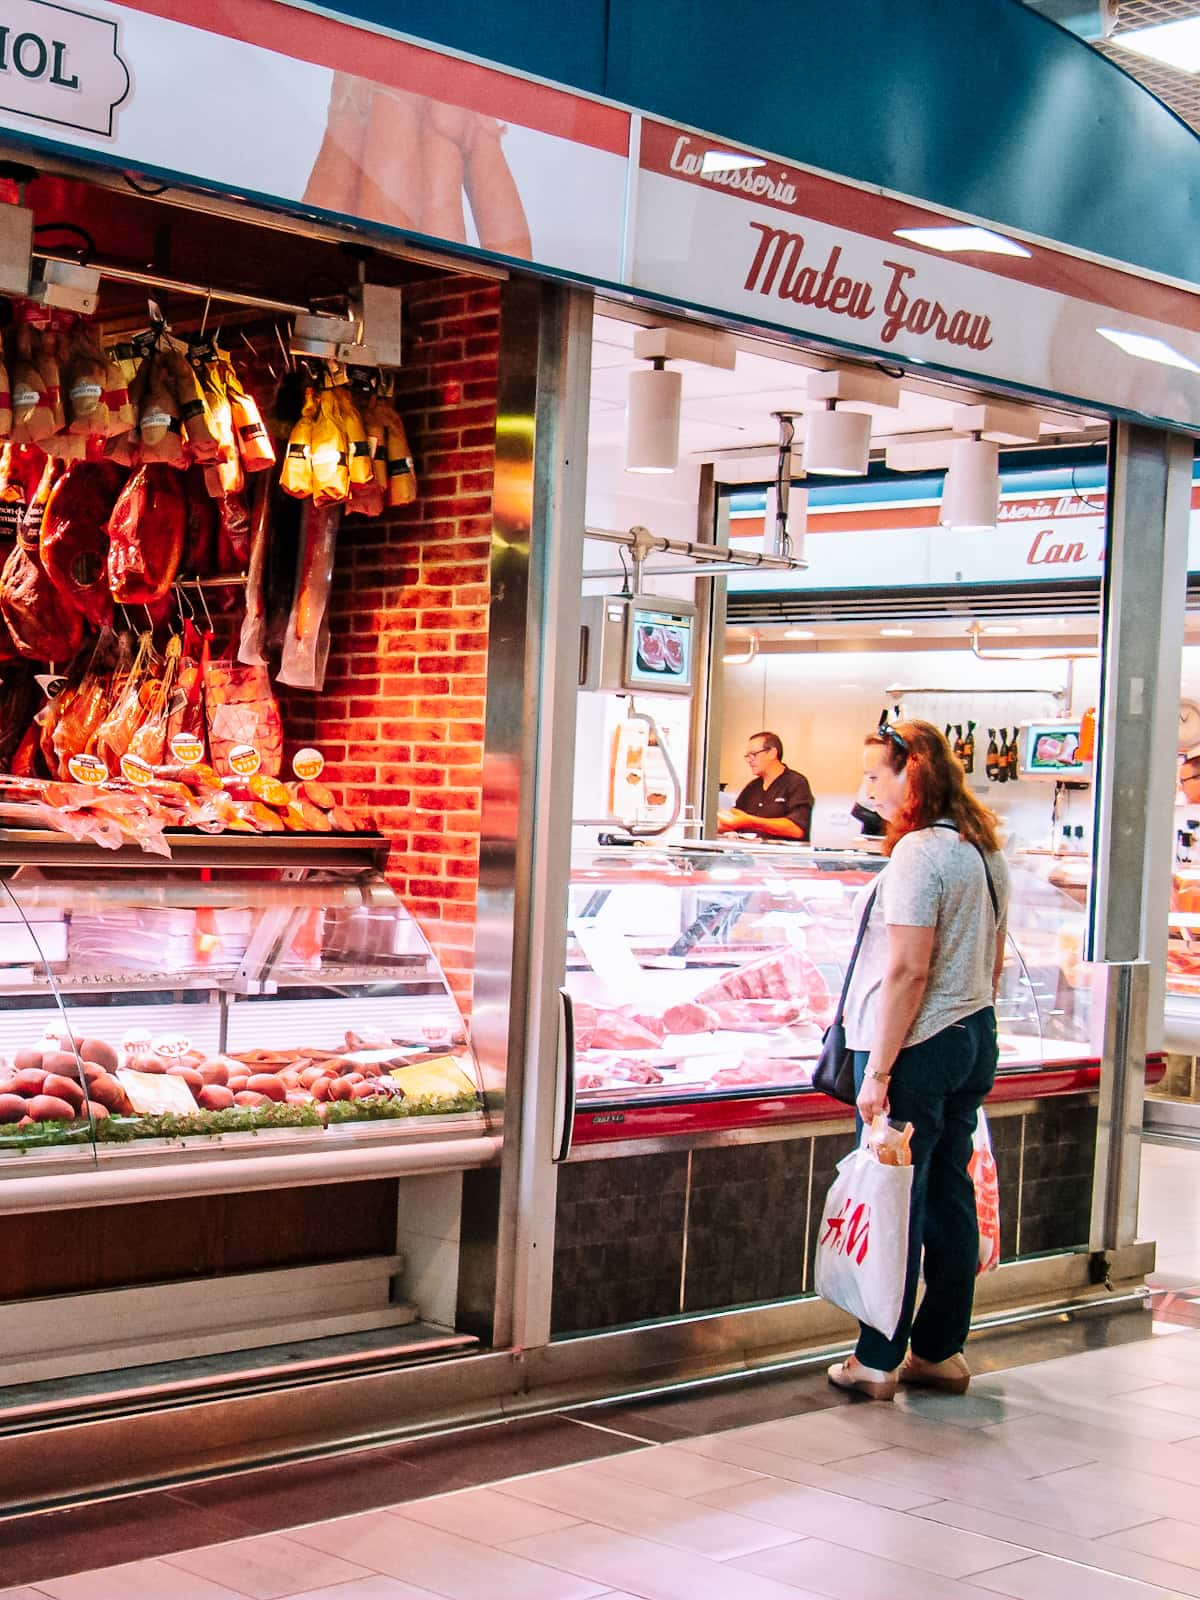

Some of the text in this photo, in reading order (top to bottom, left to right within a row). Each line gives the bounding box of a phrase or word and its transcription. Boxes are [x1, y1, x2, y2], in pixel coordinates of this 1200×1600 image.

[743, 221, 993, 351] Mateu Garau
[1026, 530, 1089, 566] Can
